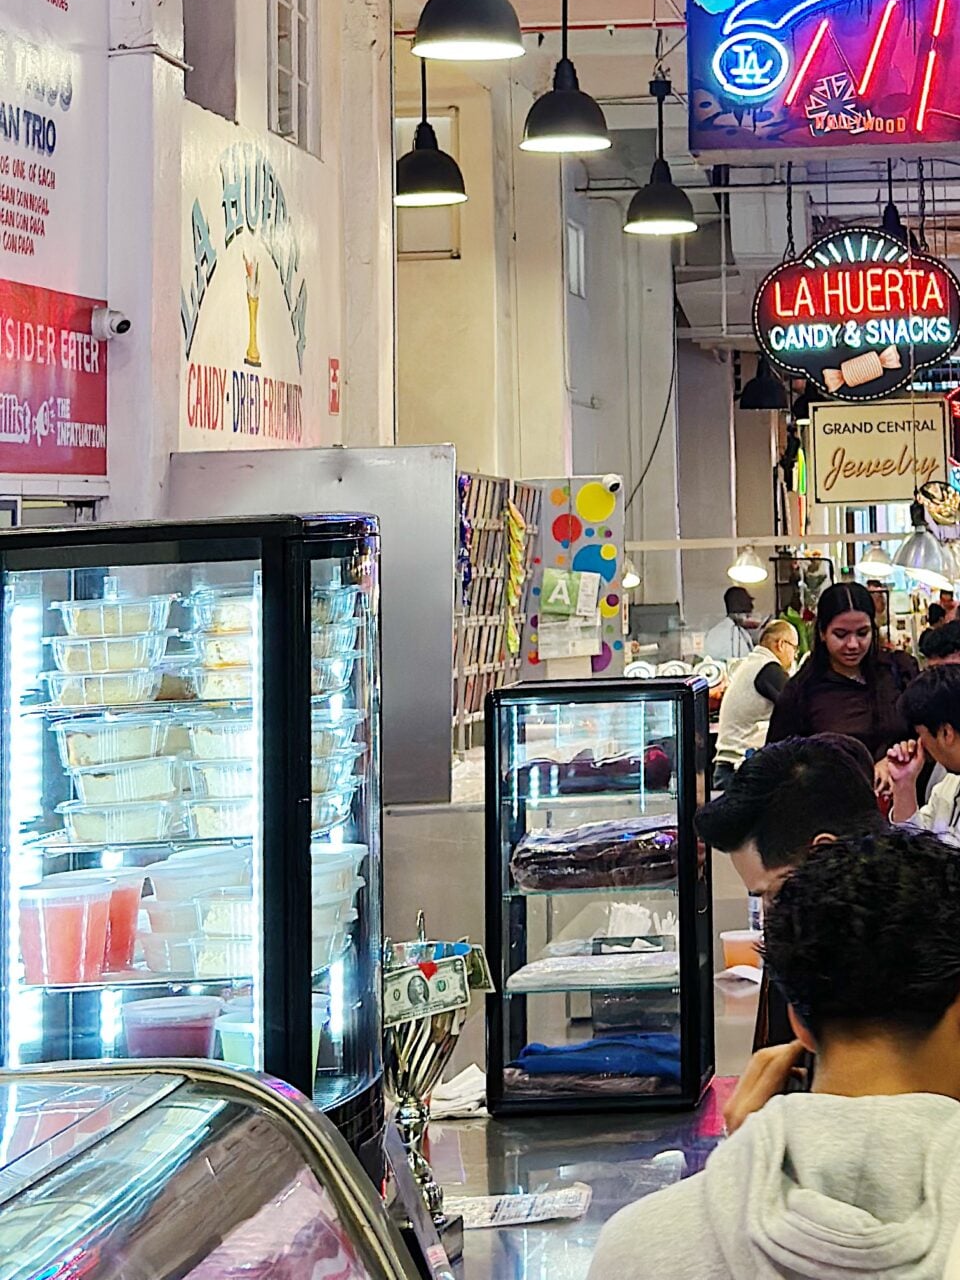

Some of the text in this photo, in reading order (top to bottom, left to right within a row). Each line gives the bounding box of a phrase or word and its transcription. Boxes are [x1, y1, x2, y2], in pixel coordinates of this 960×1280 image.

[23, 109, 57, 154] TRIO
[773, 268, 945, 318] LA HUERTA
[0, 316, 99, 373] SIDER EATER
[769, 316, 951, 351] CANDY & SNACKS
[57, 397, 71, 419] THE
[187, 362, 227, 431] CANDY
[232, 370, 261, 436] DRIED
[57, 421, 106, 450] INFATUATION
[822, 418, 937, 436] GRAND CENTRAL
[823, 444, 941, 492] Jewelry
[547, 579, 571, 605] A
